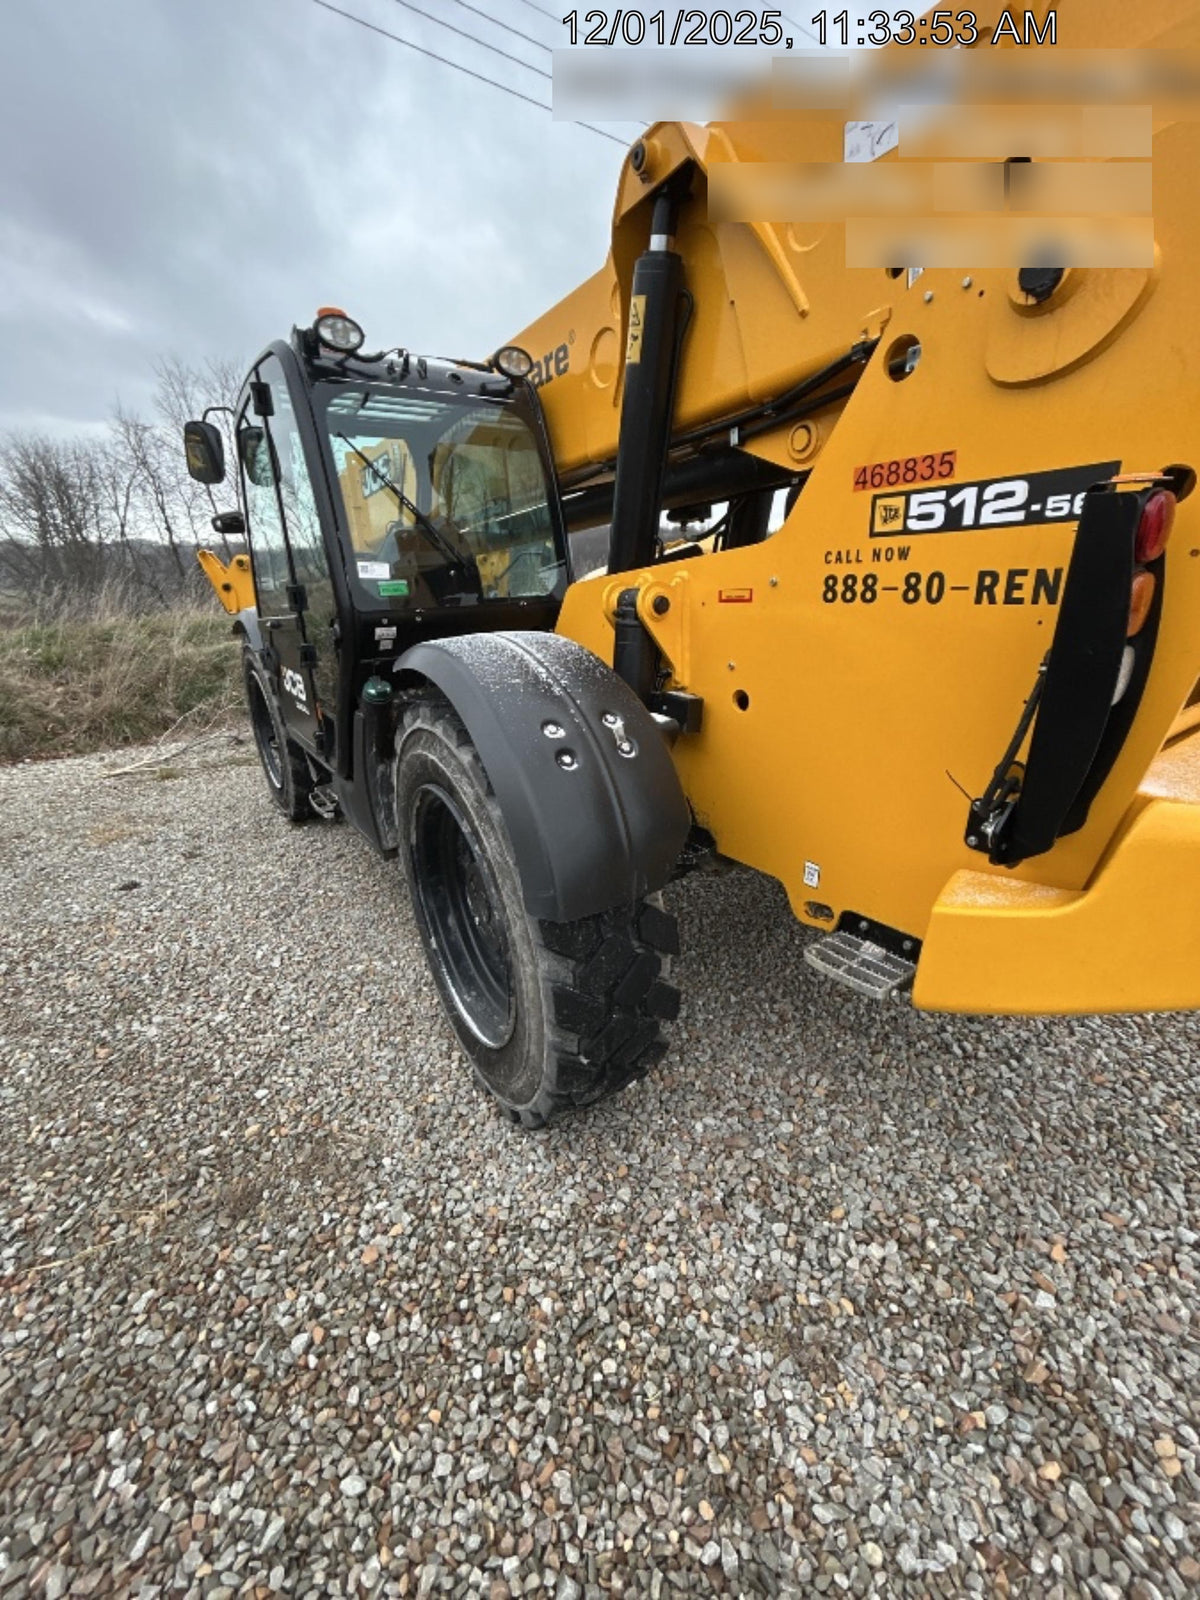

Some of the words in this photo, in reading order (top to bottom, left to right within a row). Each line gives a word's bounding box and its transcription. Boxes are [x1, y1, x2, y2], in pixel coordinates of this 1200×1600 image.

[855, 451, 955, 489] 468835
[824, 549, 863, 564] CALL
[872, 546, 911, 562] NOW
